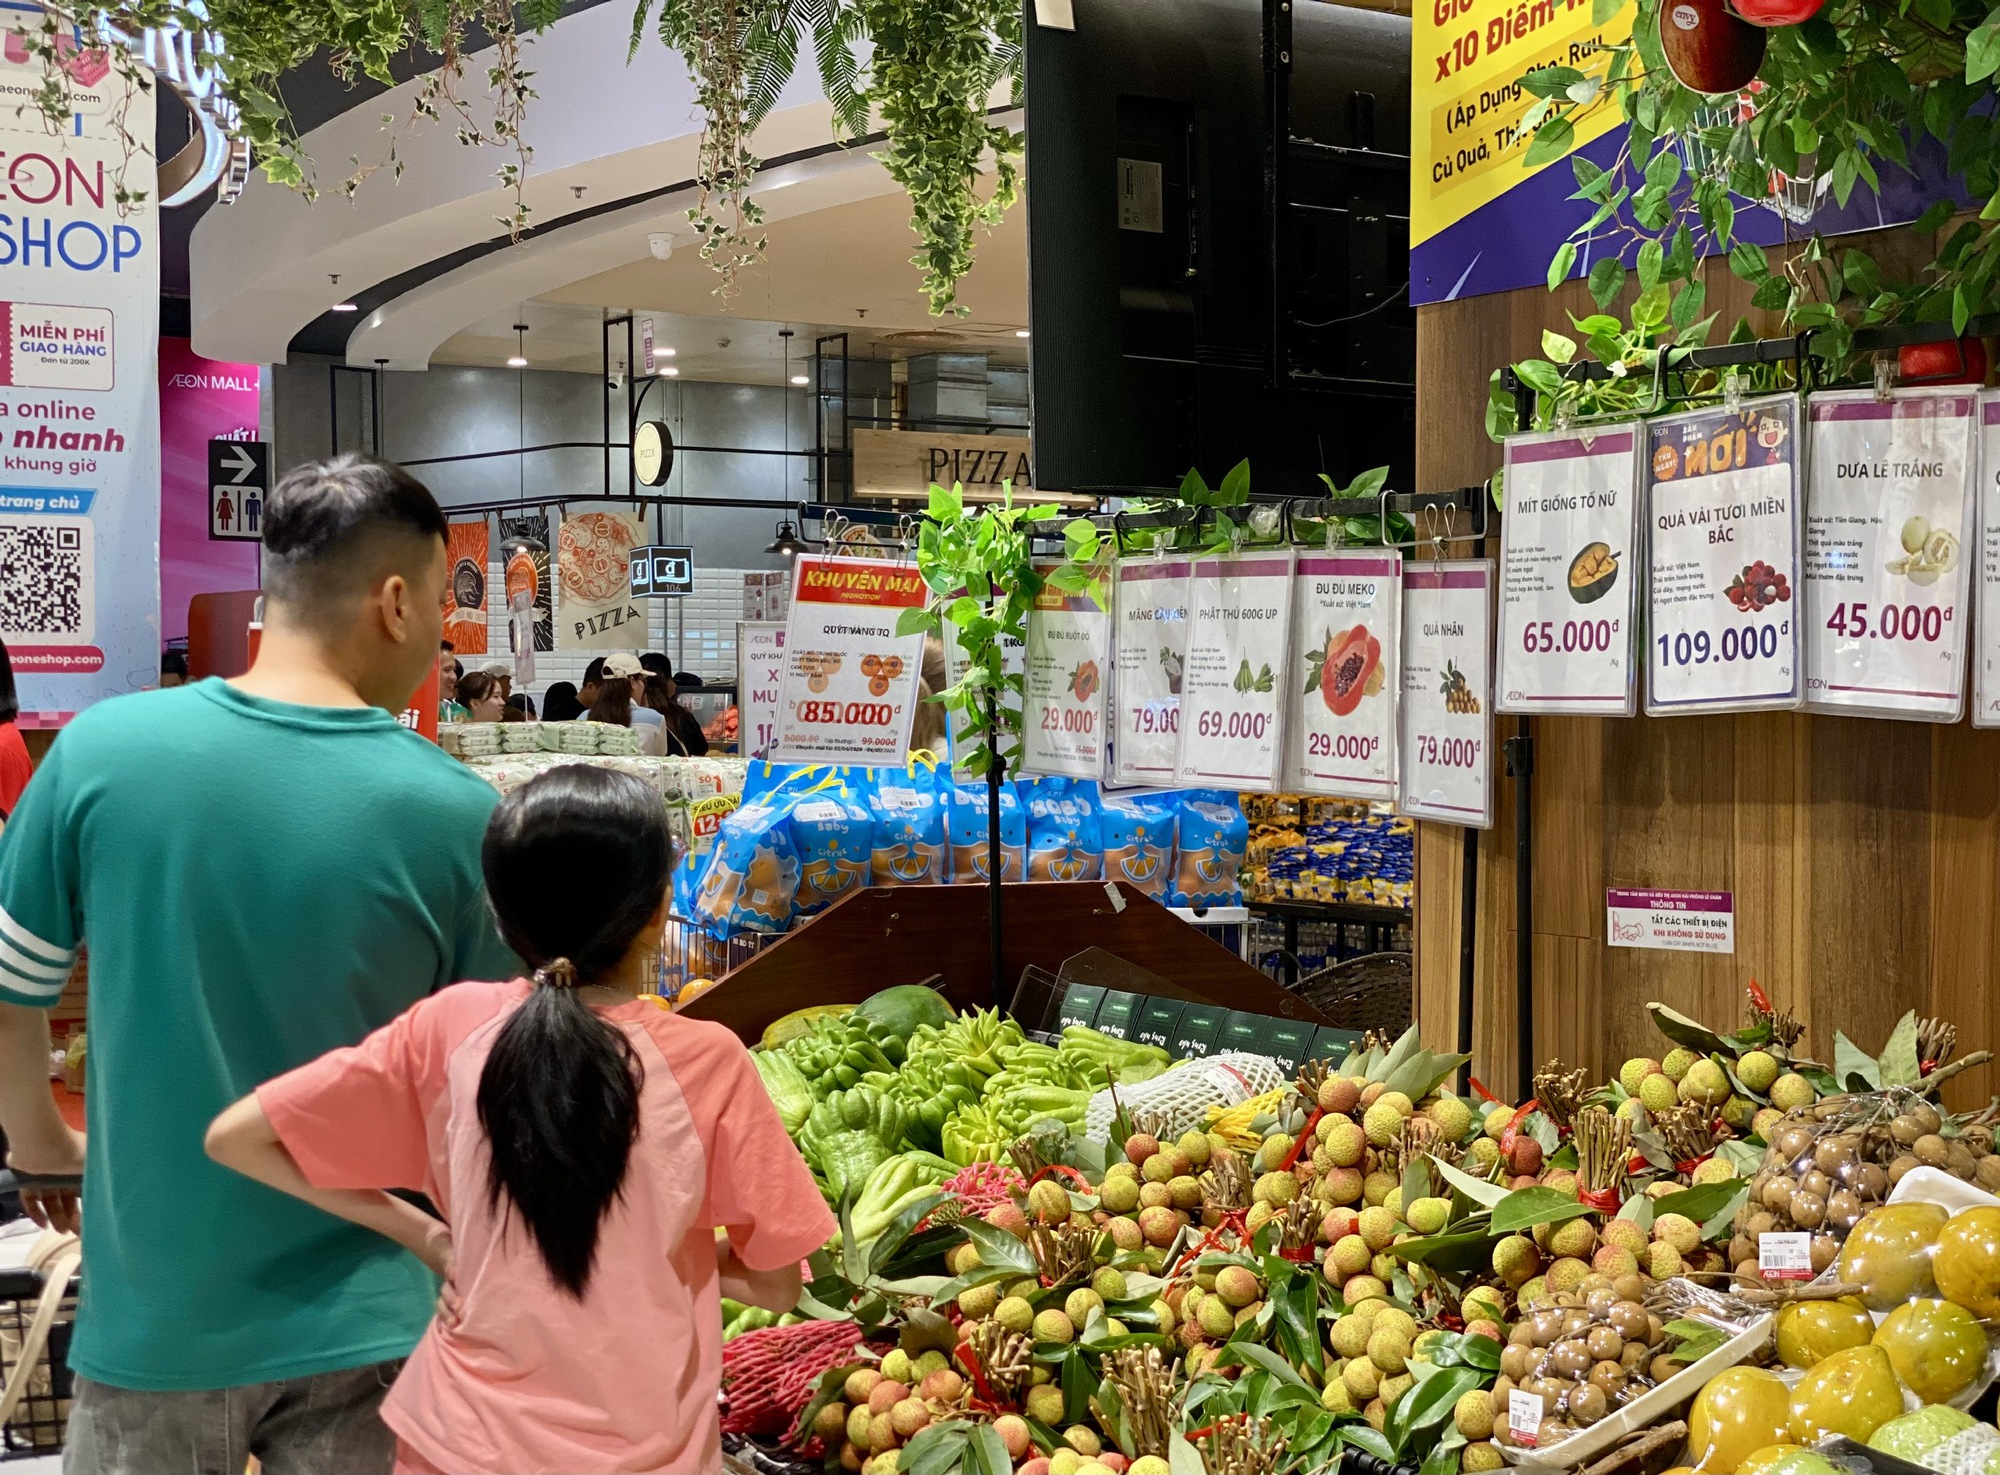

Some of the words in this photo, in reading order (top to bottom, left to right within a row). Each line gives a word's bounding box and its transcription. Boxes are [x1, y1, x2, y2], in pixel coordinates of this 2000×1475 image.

[1675, 11, 1696, 26] envy
[1435, 29, 1478, 83] x10
[1446, 101, 1476, 133] (Áp
[1480, 83, 1521, 113] Dụng
[1433, 156, 1453, 183] Củ
[1456, 138, 1490, 173] Quả,
[0, 213, 142, 273] SHOP
[20, 320, 67, 340] MIỄN
[73, 326, 105, 342] PHÍ
[20, 341, 58, 353] GIAO
[63, 342, 106, 356] HÀNG
[211, 376, 252, 391] MALL
[17, 399, 96, 421] online
[13, 425, 124, 452] nhanh
[640, 448, 656, 458] PIZZA
[1684, 424, 1747, 478] MỚI
[5, 456, 63, 475] khung
[69, 458, 97, 475] giờ
[927, 447, 1032, 487] PIZZA
[1837, 462, 1869, 478] DƯA
[1873, 459, 1888, 478] LÊ
[1893, 458, 1943, 478] TRẮNG
[49, 495, 80, 509] chủ
[1518, 498, 1538, 514] MÍT
[1541, 493, 1577, 512] GIỐNG
[1580, 491, 1596, 509] TỐ
[1598, 490, 1617, 507] NỮ
[1658, 510, 1686, 531] QUẢ
[1689, 506, 1710, 525] VẢI
[1714, 504, 1746, 521] TƯƠI
[1750, 496, 1785, 517] MIỀN
[1708, 524, 1734, 545] BẮC
[666, 584, 681, 593] 106
[804, 568, 882, 591] KHUYẾN
[885, 575, 920, 597] MẠI
[1316, 583, 1330, 594] ĐU
[1332, 579, 1345, 594] ĐỦ
[1347, 583, 1375, 595] MEKO
[574, 604, 641, 641] PIZZA
[1199, 606, 1220, 622] PHẬT
[1222, 606, 1239, 620] THỦ
[1241, 609, 1263, 620] 600G
[1265, 609, 1278, 620] UP
[1826, 602, 1954, 642] 45.000đ
[1423, 620, 1440, 637] QUẢ
[1441, 620, 1464, 637] NHÃN
[1523, 619, 1620, 654] 65.000đ
[1657, 620, 1789, 666] 109.000đ
[804, 700, 902, 726] 85.000đ
[1041, 706, 1098, 734] 29.000đ
[1199, 710, 1272, 739] 69.000đ
[1308, 732, 1379, 760] 29.000đ
[1417, 735, 1480, 768] 79.000đ
[890, 811, 918, 821] Baby
[817, 821, 849, 834] Baby
[818, 848, 847, 858] Citrus
[1650, 899, 1674, 909] THÔNG
[1676, 901, 1686, 909] TIN
[1665, 915, 1680, 925] CÁC
[1683, 916, 1700, 926] THIẾT
[1702, 919, 1709, 928] BỊ
[1667, 928, 1693, 938] KHÔNG
[1705, 932, 1726, 941] DỤNG
